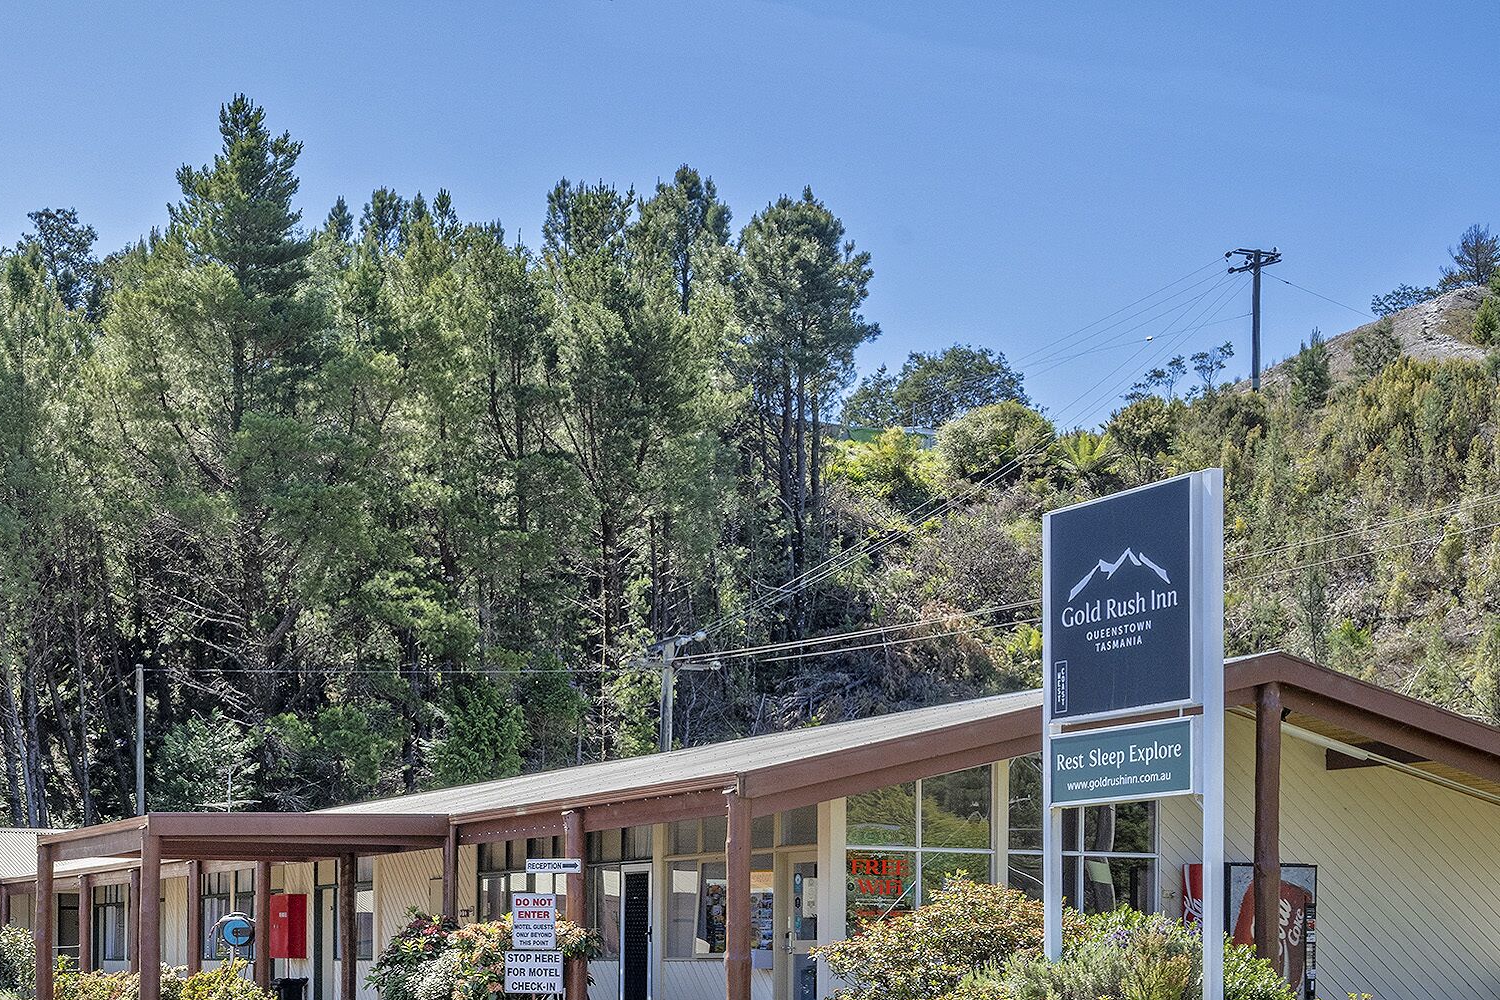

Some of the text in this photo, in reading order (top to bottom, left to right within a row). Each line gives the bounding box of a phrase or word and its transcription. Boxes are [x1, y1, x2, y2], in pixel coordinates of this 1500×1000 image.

[1061, 590, 1178, 628] Gold Rush Inn
[1086, 620, 1152, 640] QUEENSTOWN
[1095, 636, 1142, 652] TASMANIA
[1056, 741, 1182, 771] Rest Sleep Explore
[1066, 772, 1171, 790] www.goldrushinn.com.au
[850, 859, 909, 876] FREE
[855, 879, 903, 896] WiFi
[1288, 908, 1304, 946] Coke
[507, 954, 560, 962] STOP HERE
[507, 968, 560, 976] FOR MOTEL
[511, 982, 556, 990] CHECK-IN
